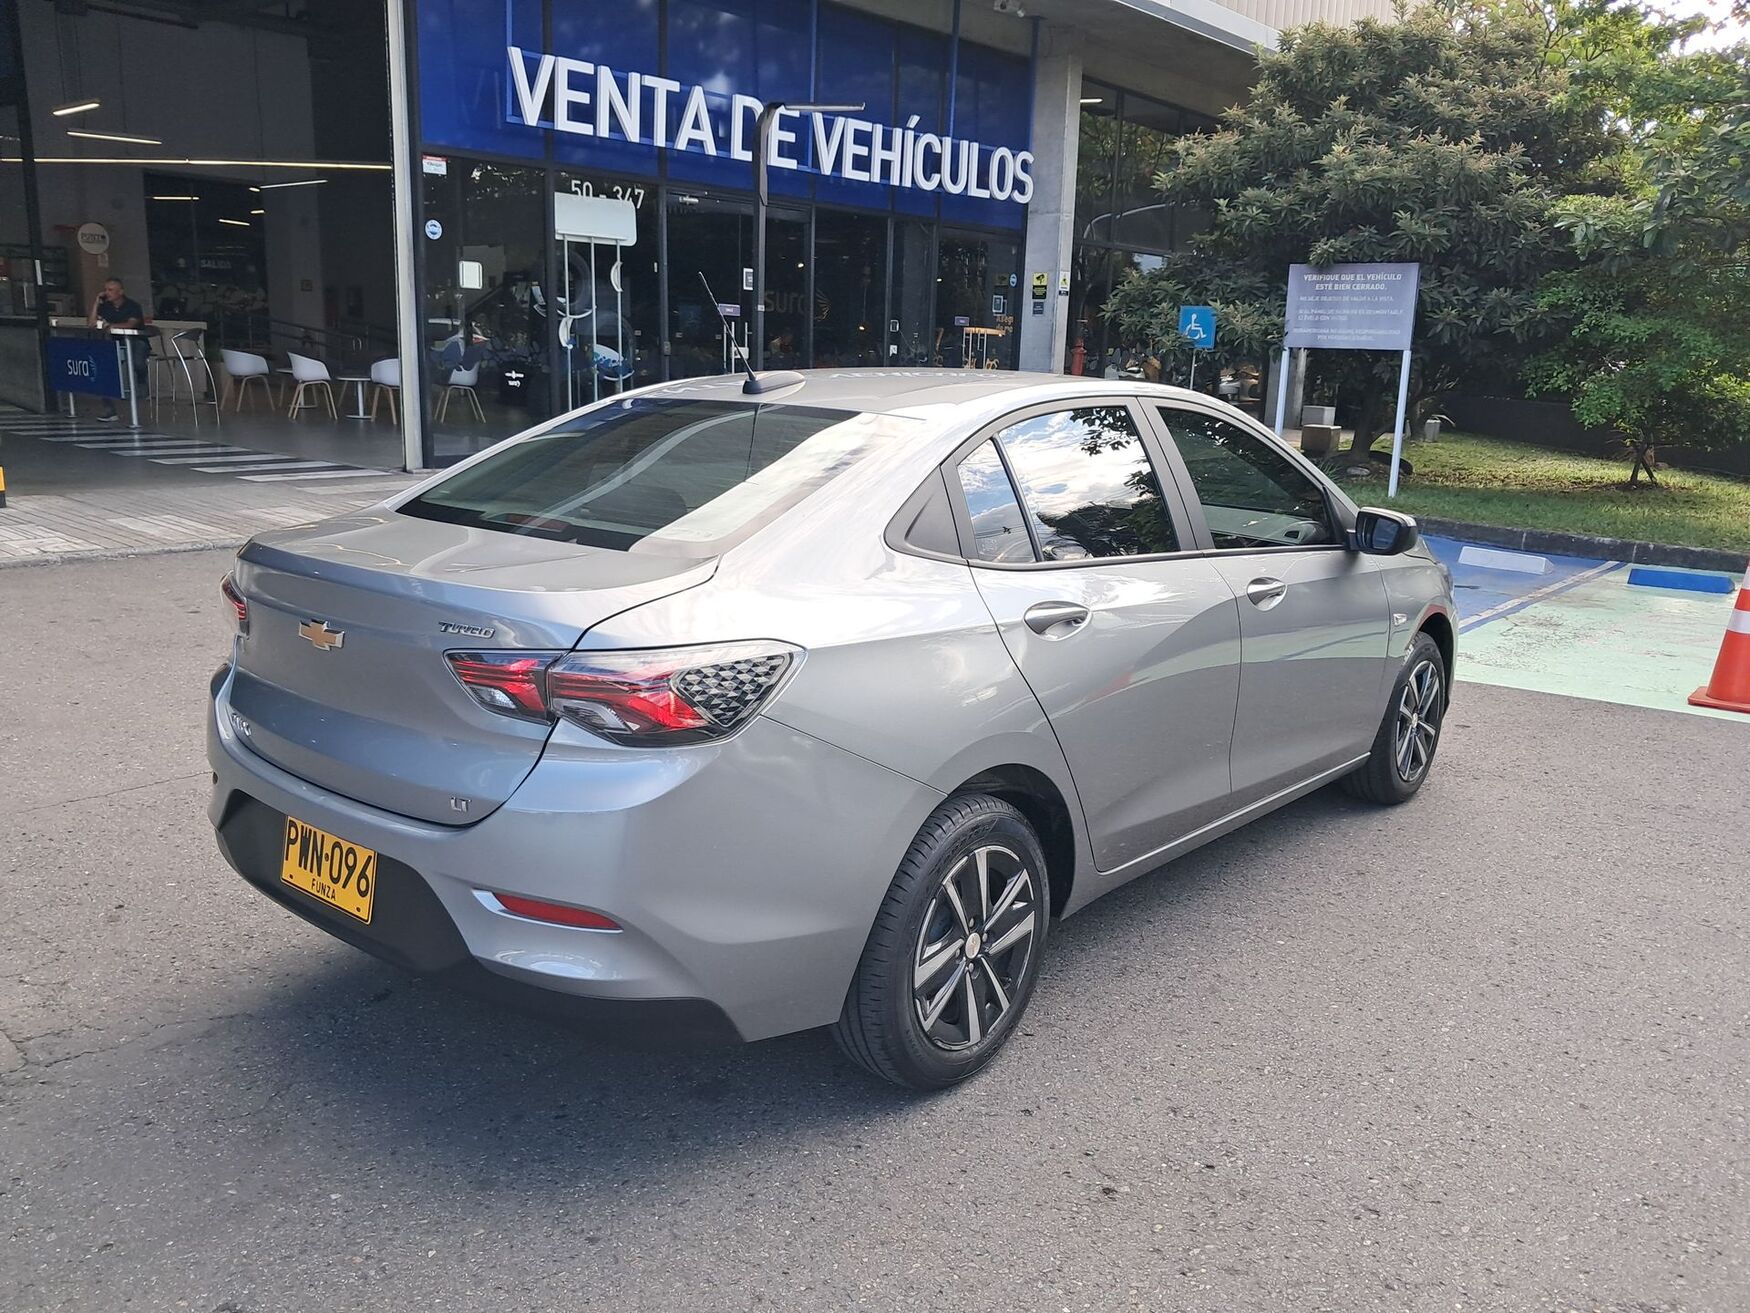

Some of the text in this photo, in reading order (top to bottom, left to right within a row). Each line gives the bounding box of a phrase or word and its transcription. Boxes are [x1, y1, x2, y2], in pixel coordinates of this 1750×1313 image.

[508, 46, 1034, 204] VENTA DE VEHÍCULOS
[1303, 272, 1402, 281] VERIFIQUE QUE EL VEHÍCULO
[1334, 283, 1351, 291] BIEN
[67, 359, 89, 377] sura
[450, 796, 471, 812] LT
[311, 878, 337, 902] FUNZA
